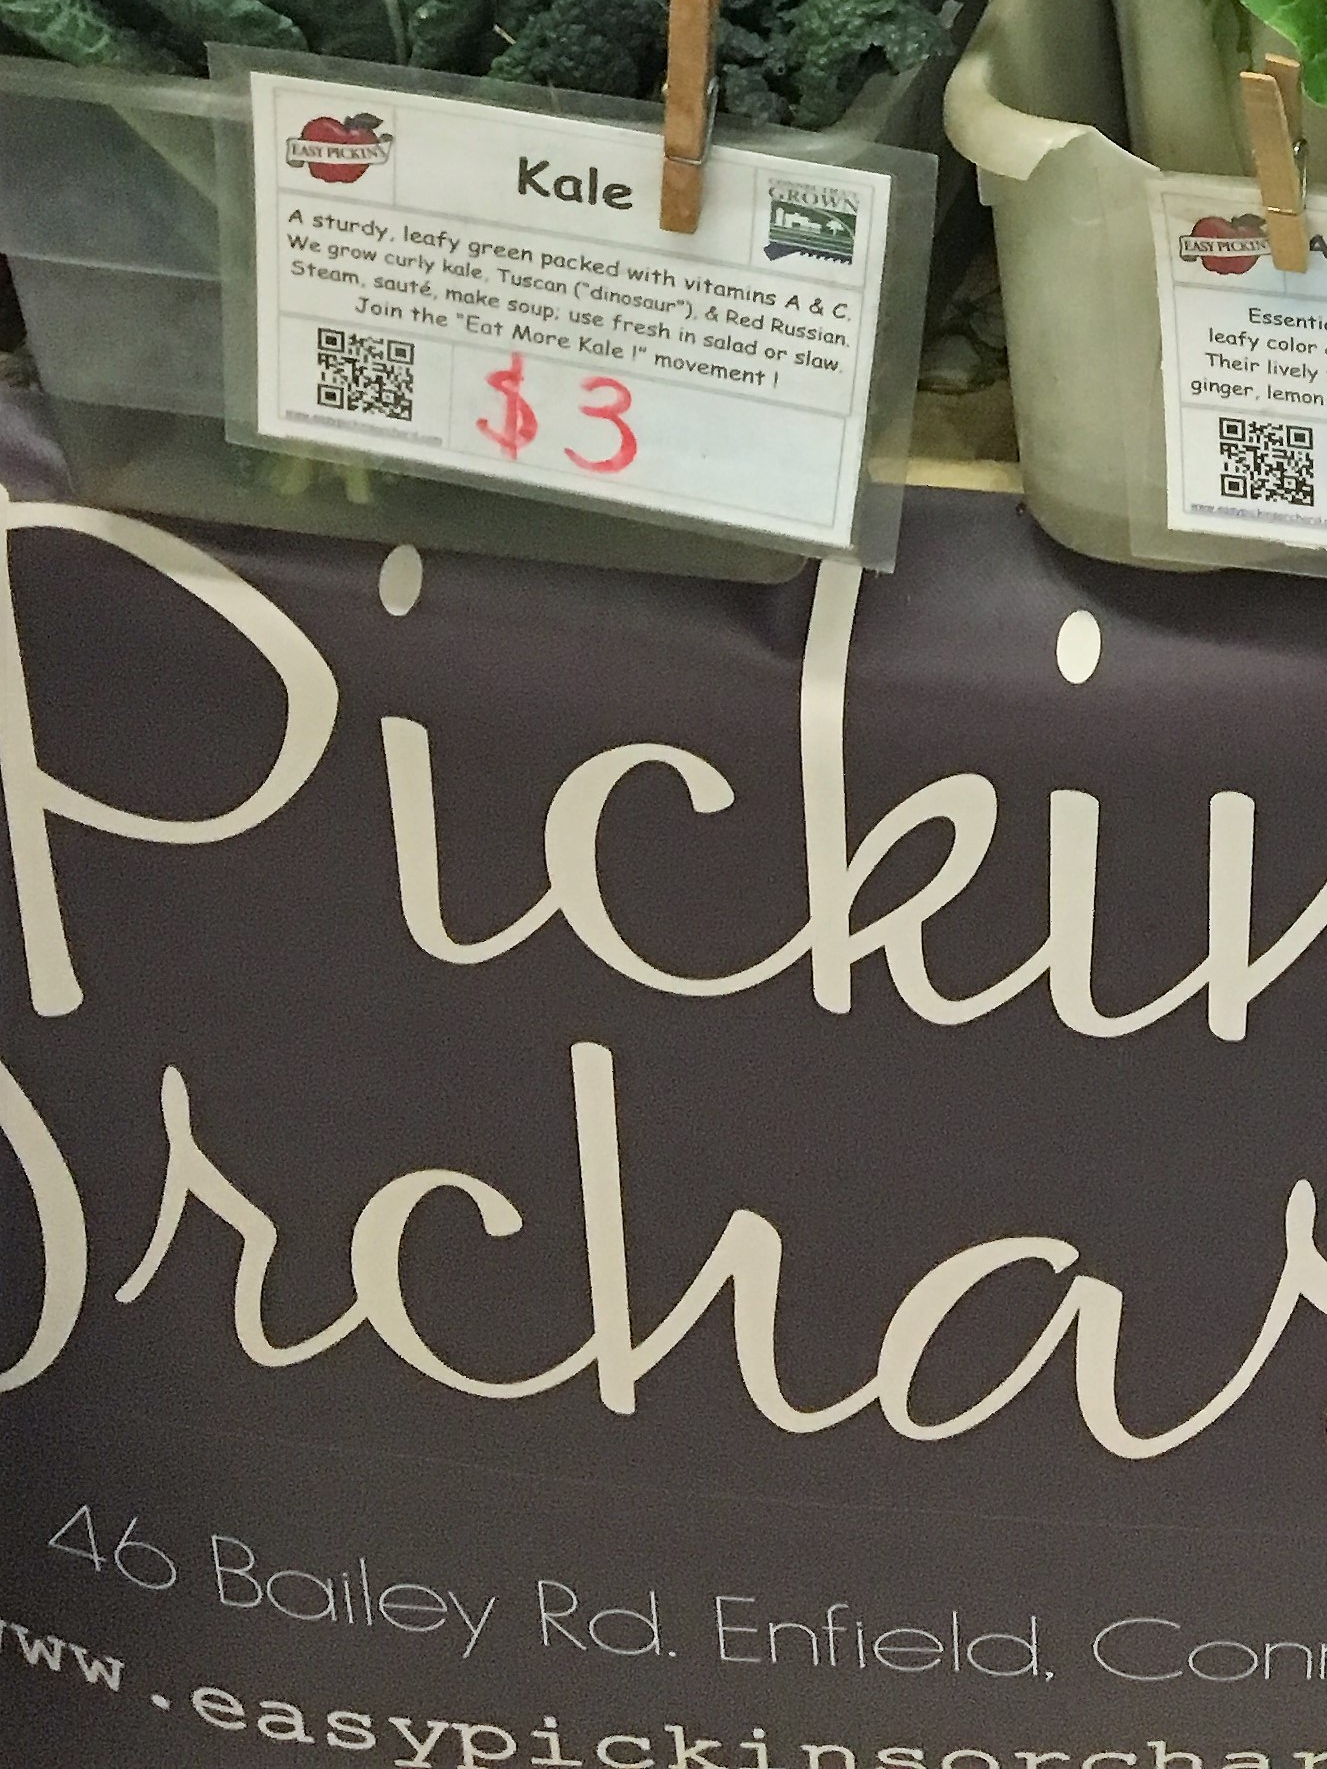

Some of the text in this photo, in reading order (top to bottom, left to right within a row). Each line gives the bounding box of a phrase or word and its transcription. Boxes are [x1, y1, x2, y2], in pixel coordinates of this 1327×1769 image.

[518, 156, 633, 210] Kale
[288, 209, 851, 321] A sturdy, leafy green packed with vitamins A C.
[1184, 241, 1214, 252] EASY
[288, 233, 321, 252] We
[328, 243, 377, 261] grow
[384, 252, 435, 274] curly
[442, 258, 489, 282] kale,
[497, 268, 567, 294] Tuscan
[726, 309, 764, 330] Red
[771, 316, 850, 347] Russian.
[291, 260, 366, 288] Steam,
[374, 276, 438, 300] sauté,
[445, 288, 499, 308] make
[569, 311, 604, 327] use
[612, 314, 671, 340] fresh
[679, 328, 696, 343] in
[703, 334, 758, 356] salad
[764, 347, 787, 362] or
[794, 351, 843, 374] slaw.
[355, 296, 765, 386] Join the "Eat More Kale movement
[1205, 352, 1260, 372] Their
[1267, 359, 1318, 383] lively
[1209, 327, 1259, 351] leafy
[1267, 337, 1317, 354] color
[1191, 380, 1260, 401] ginger,
[1267, 384, 1323, 406] lemon
[47, 1503, 176, 1591] 46
[211, 1533, 497, 1660] Bailey
[538, 1579, 677, 1657] Rd.
[715, 1595, 1054, 1684] Enfield,
